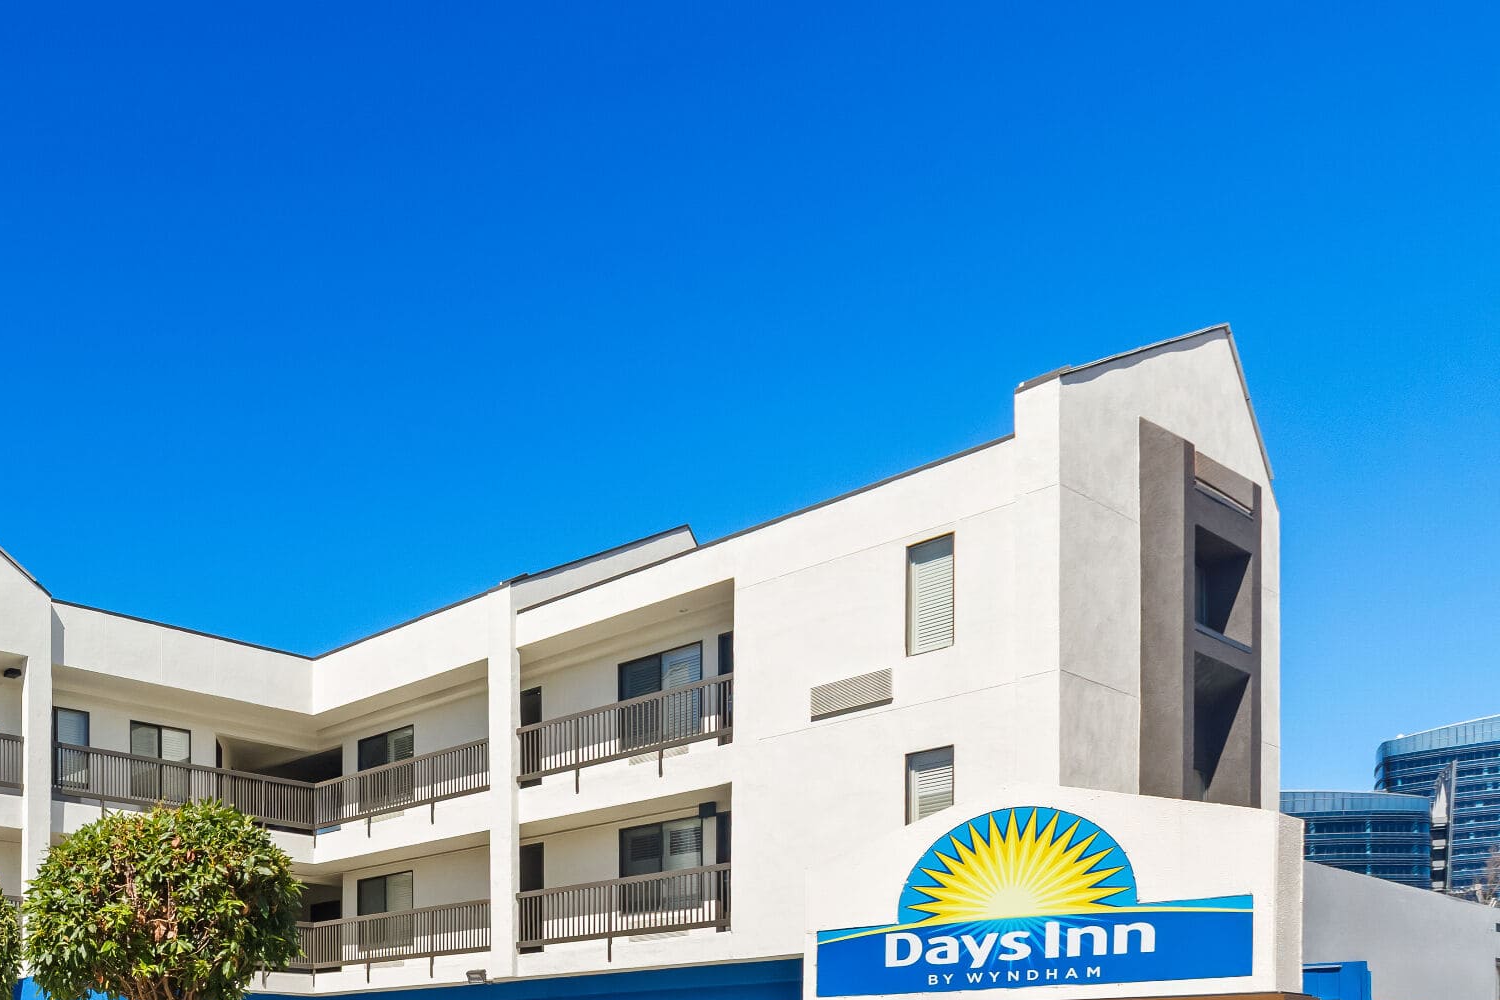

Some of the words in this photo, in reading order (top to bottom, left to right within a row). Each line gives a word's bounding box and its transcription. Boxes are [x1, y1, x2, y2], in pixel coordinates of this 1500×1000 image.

[884, 930, 1032, 969] Days
[1044, 921, 1156, 959] Inn
[927, 973, 954, 986] BY
[966, 966, 1102, 984] WYNDHAM
